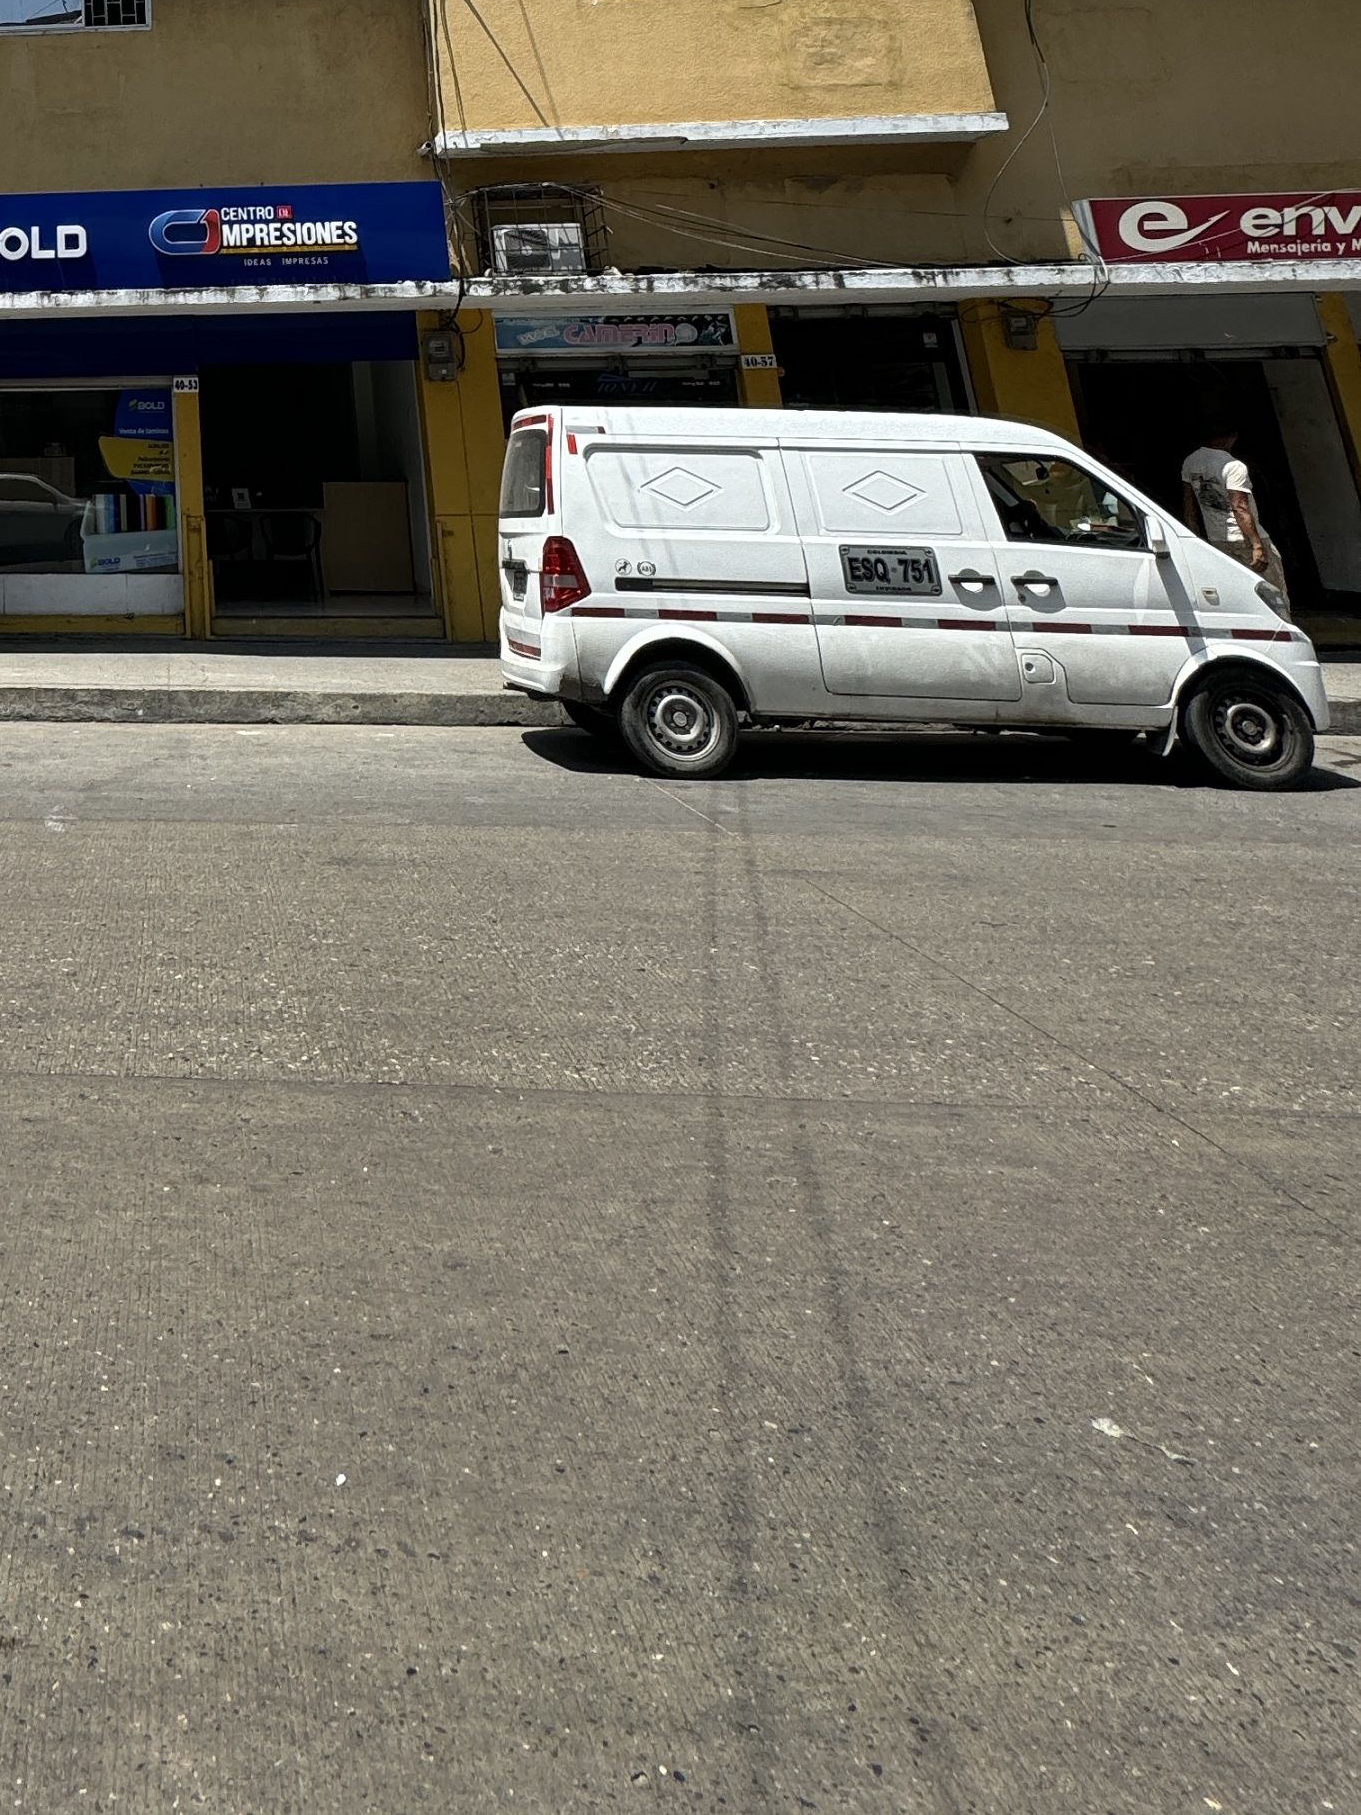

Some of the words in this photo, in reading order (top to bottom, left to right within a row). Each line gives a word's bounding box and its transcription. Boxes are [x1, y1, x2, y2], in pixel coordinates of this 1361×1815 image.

[221, 206, 274, 221] CENTRO
[1335, 242, 1346, 255] y
[243, 258, 272, 267] IDEAS
[282, 257, 329, 266] IMPRESAS
[175, 379, 198, 390] 40-53
[137, 401, 165, 411] BOLD
[97, 557, 121, 566] BOLD
